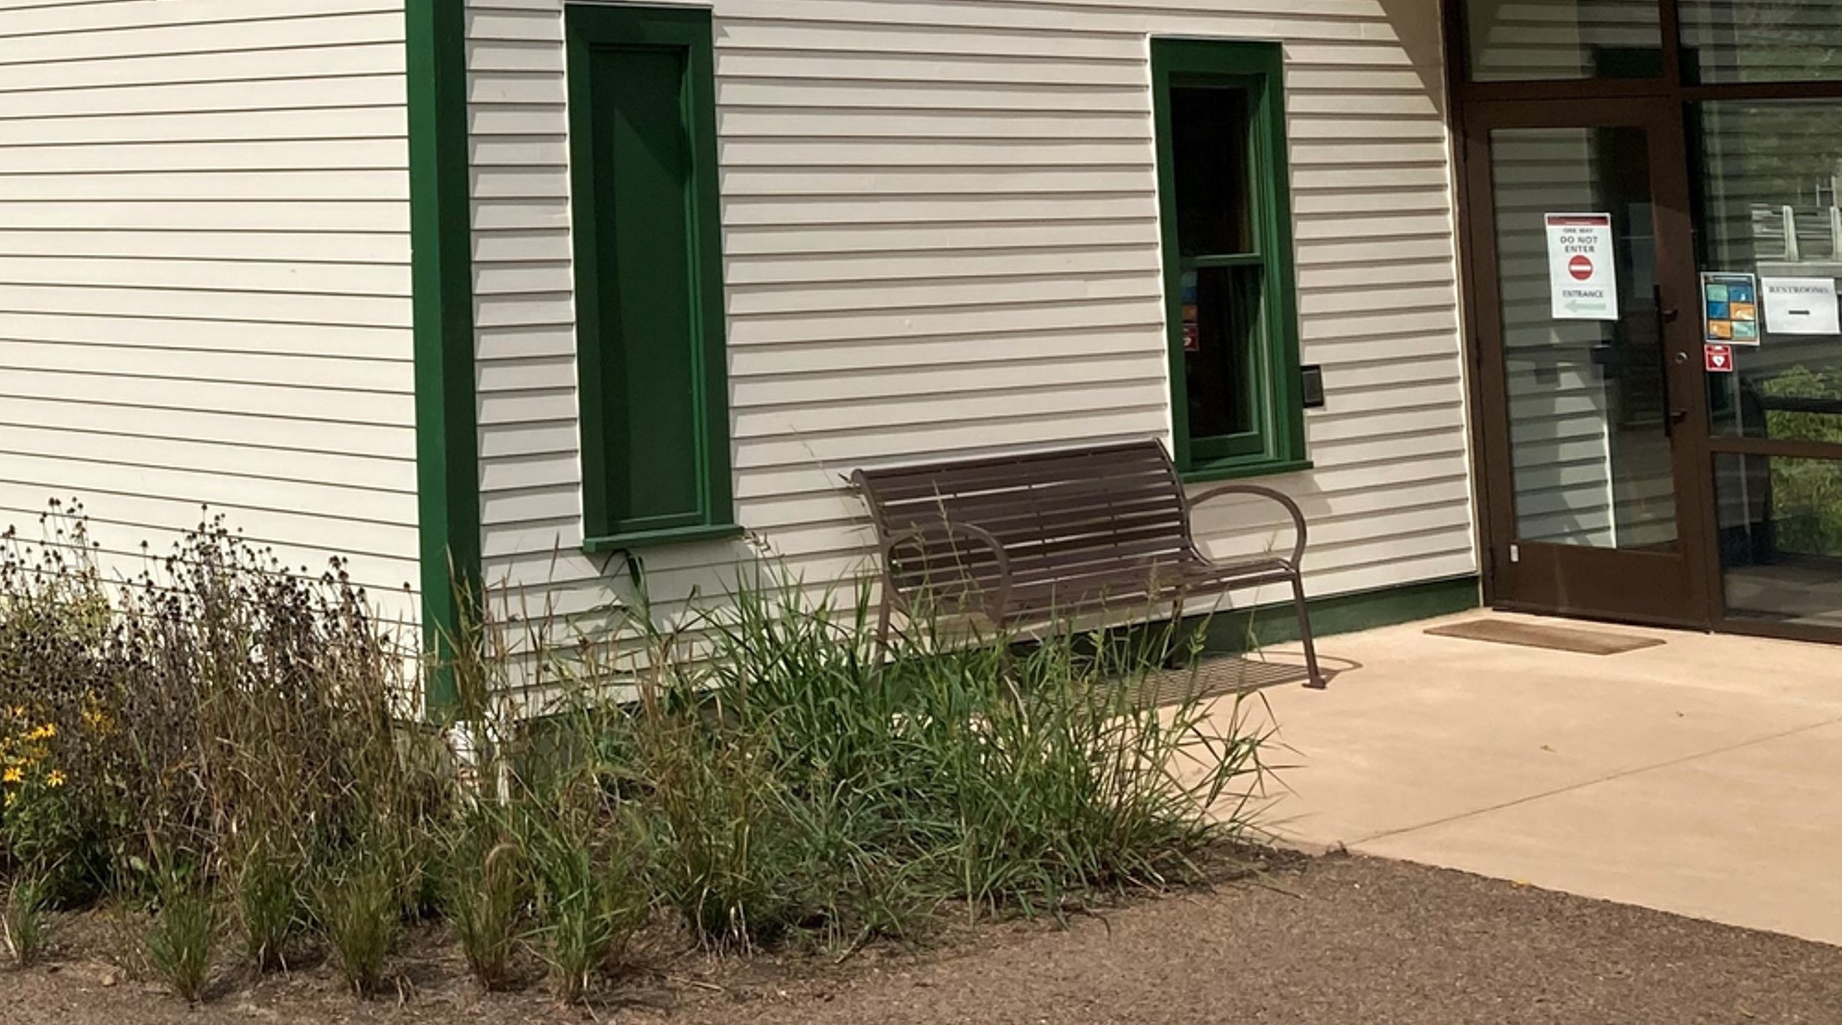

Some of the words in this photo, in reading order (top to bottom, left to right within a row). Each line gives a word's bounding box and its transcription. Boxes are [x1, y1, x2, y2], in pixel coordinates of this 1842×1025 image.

[1560, 236, 1575, 244] DO
[1578, 235, 1598, 244] NOT
[1564, 245, 1595, 253] ENTER
[1768, 285, 1829, 294] RESTROOMS
[1562, 290, 1604, 298] ENTRANCE
